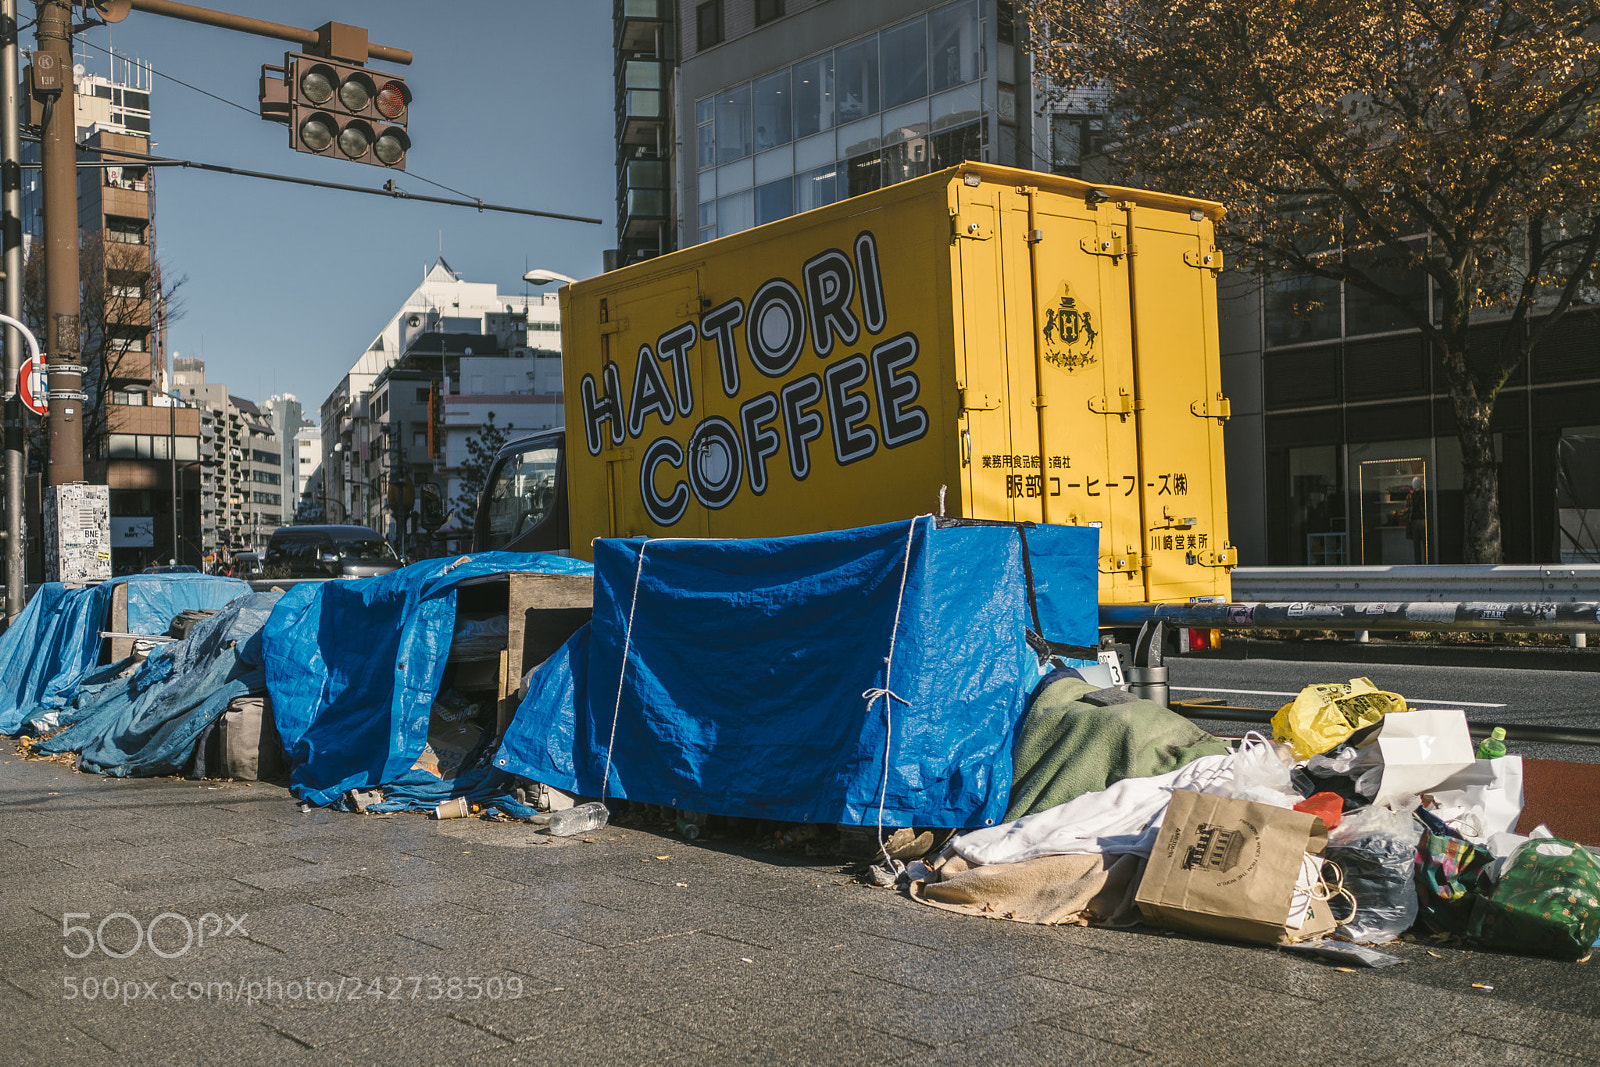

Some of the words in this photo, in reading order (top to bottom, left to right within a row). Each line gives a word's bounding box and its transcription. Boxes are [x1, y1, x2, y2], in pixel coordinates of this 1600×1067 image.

[580, 230, 887, 456] HATTORI
[639, 331, 929, 527] COFFEE
[1151, 534, 1208, 551] 川崎営業所
